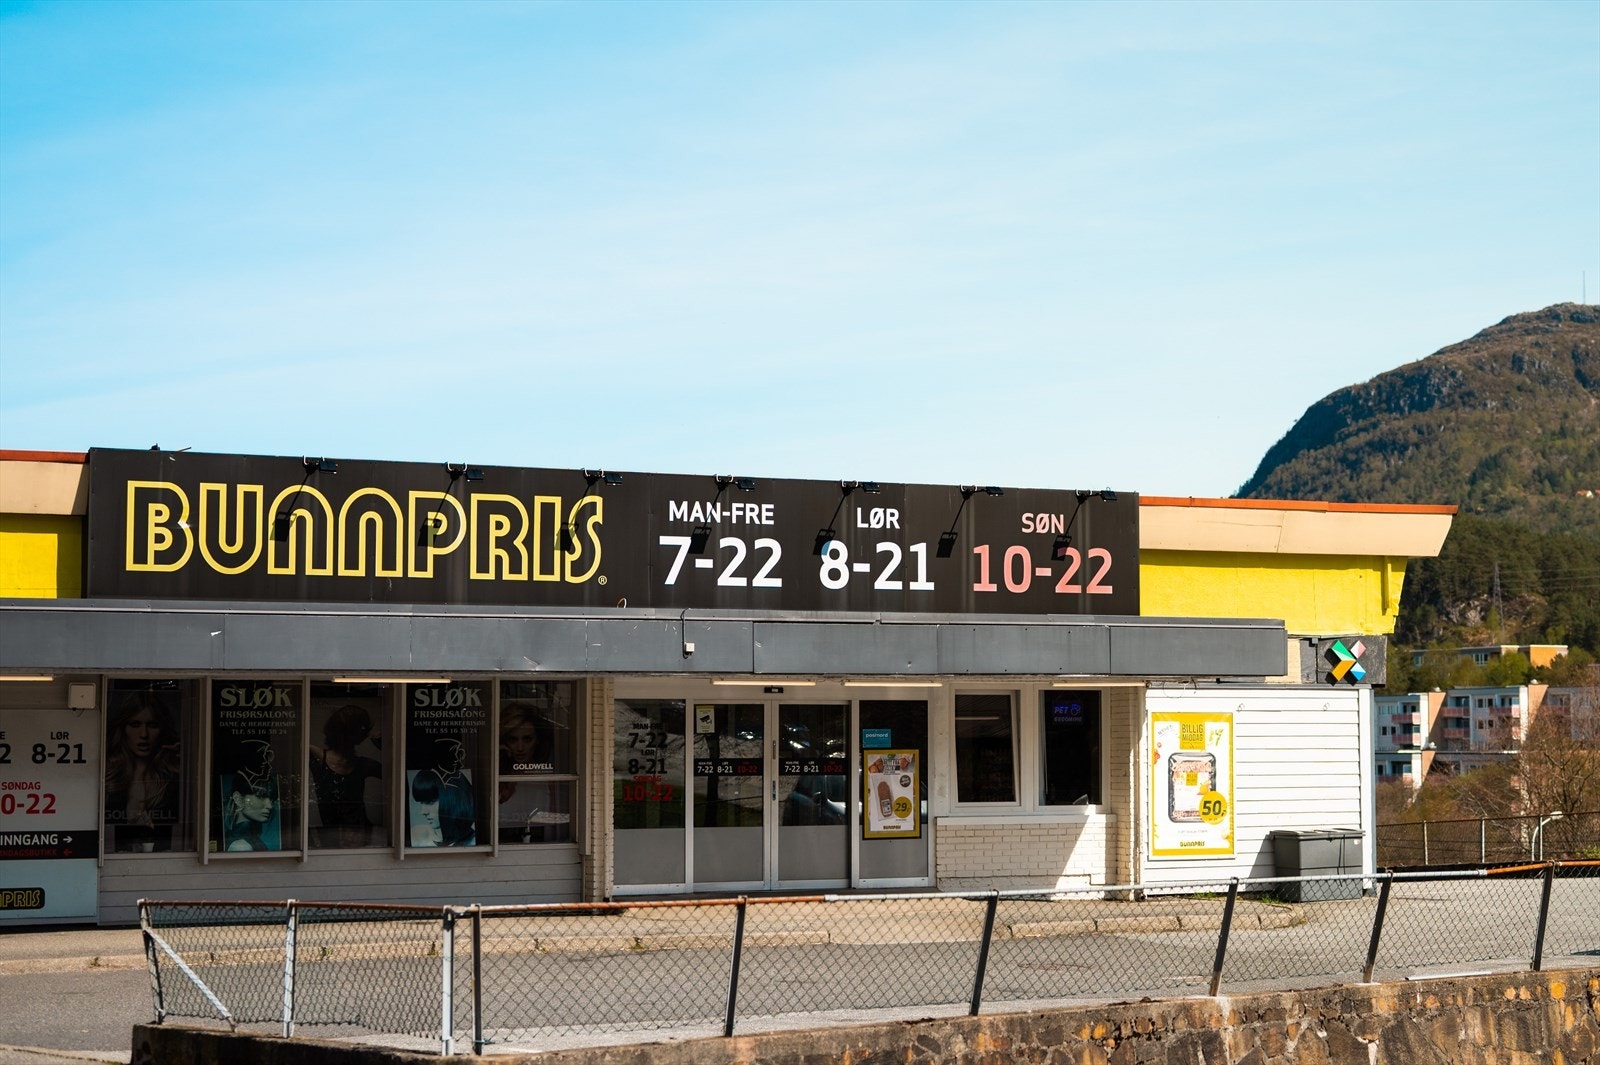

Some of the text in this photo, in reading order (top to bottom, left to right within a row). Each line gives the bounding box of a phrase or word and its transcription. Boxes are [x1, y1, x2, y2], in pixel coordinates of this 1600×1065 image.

[669, 500, 775, 525] MAN-FRE
[856, 507, 900, 529] LØR
[126, 480, 603, 584] BUNNPRIS
[1021, 512, 1064, 534] SØN
[659, 536, 782, 588] 7-22
[819, 539, 935, 591] 8-21
[973, 544, 1113, 594] 10-22
[220, 686, 293, 709] SLØK
[414, 686, 482, 709] SLØK
[220, 710, 296, 719] FRISØRSALONG
[414, 710, 486, 719] FRISØRSALONG
[50, 731, 69, 740] LØR
[1182, 724, 1203, 733] BILLIG
[628, 732, 668, 748] 7-22
[31, 743, 87, 764] 8-21
[513, 763, 554, 771] GOLDWELL
[628, 758, 668, 774] 8-21
[784, 765, 800, 773] 7-22
[803, 765, 820, 773] 8-21
[1, 781, 41, 790] SØNDAG
[623, 784, 673, 802] 10-22
[0, 890, 40, 908] PRIS
